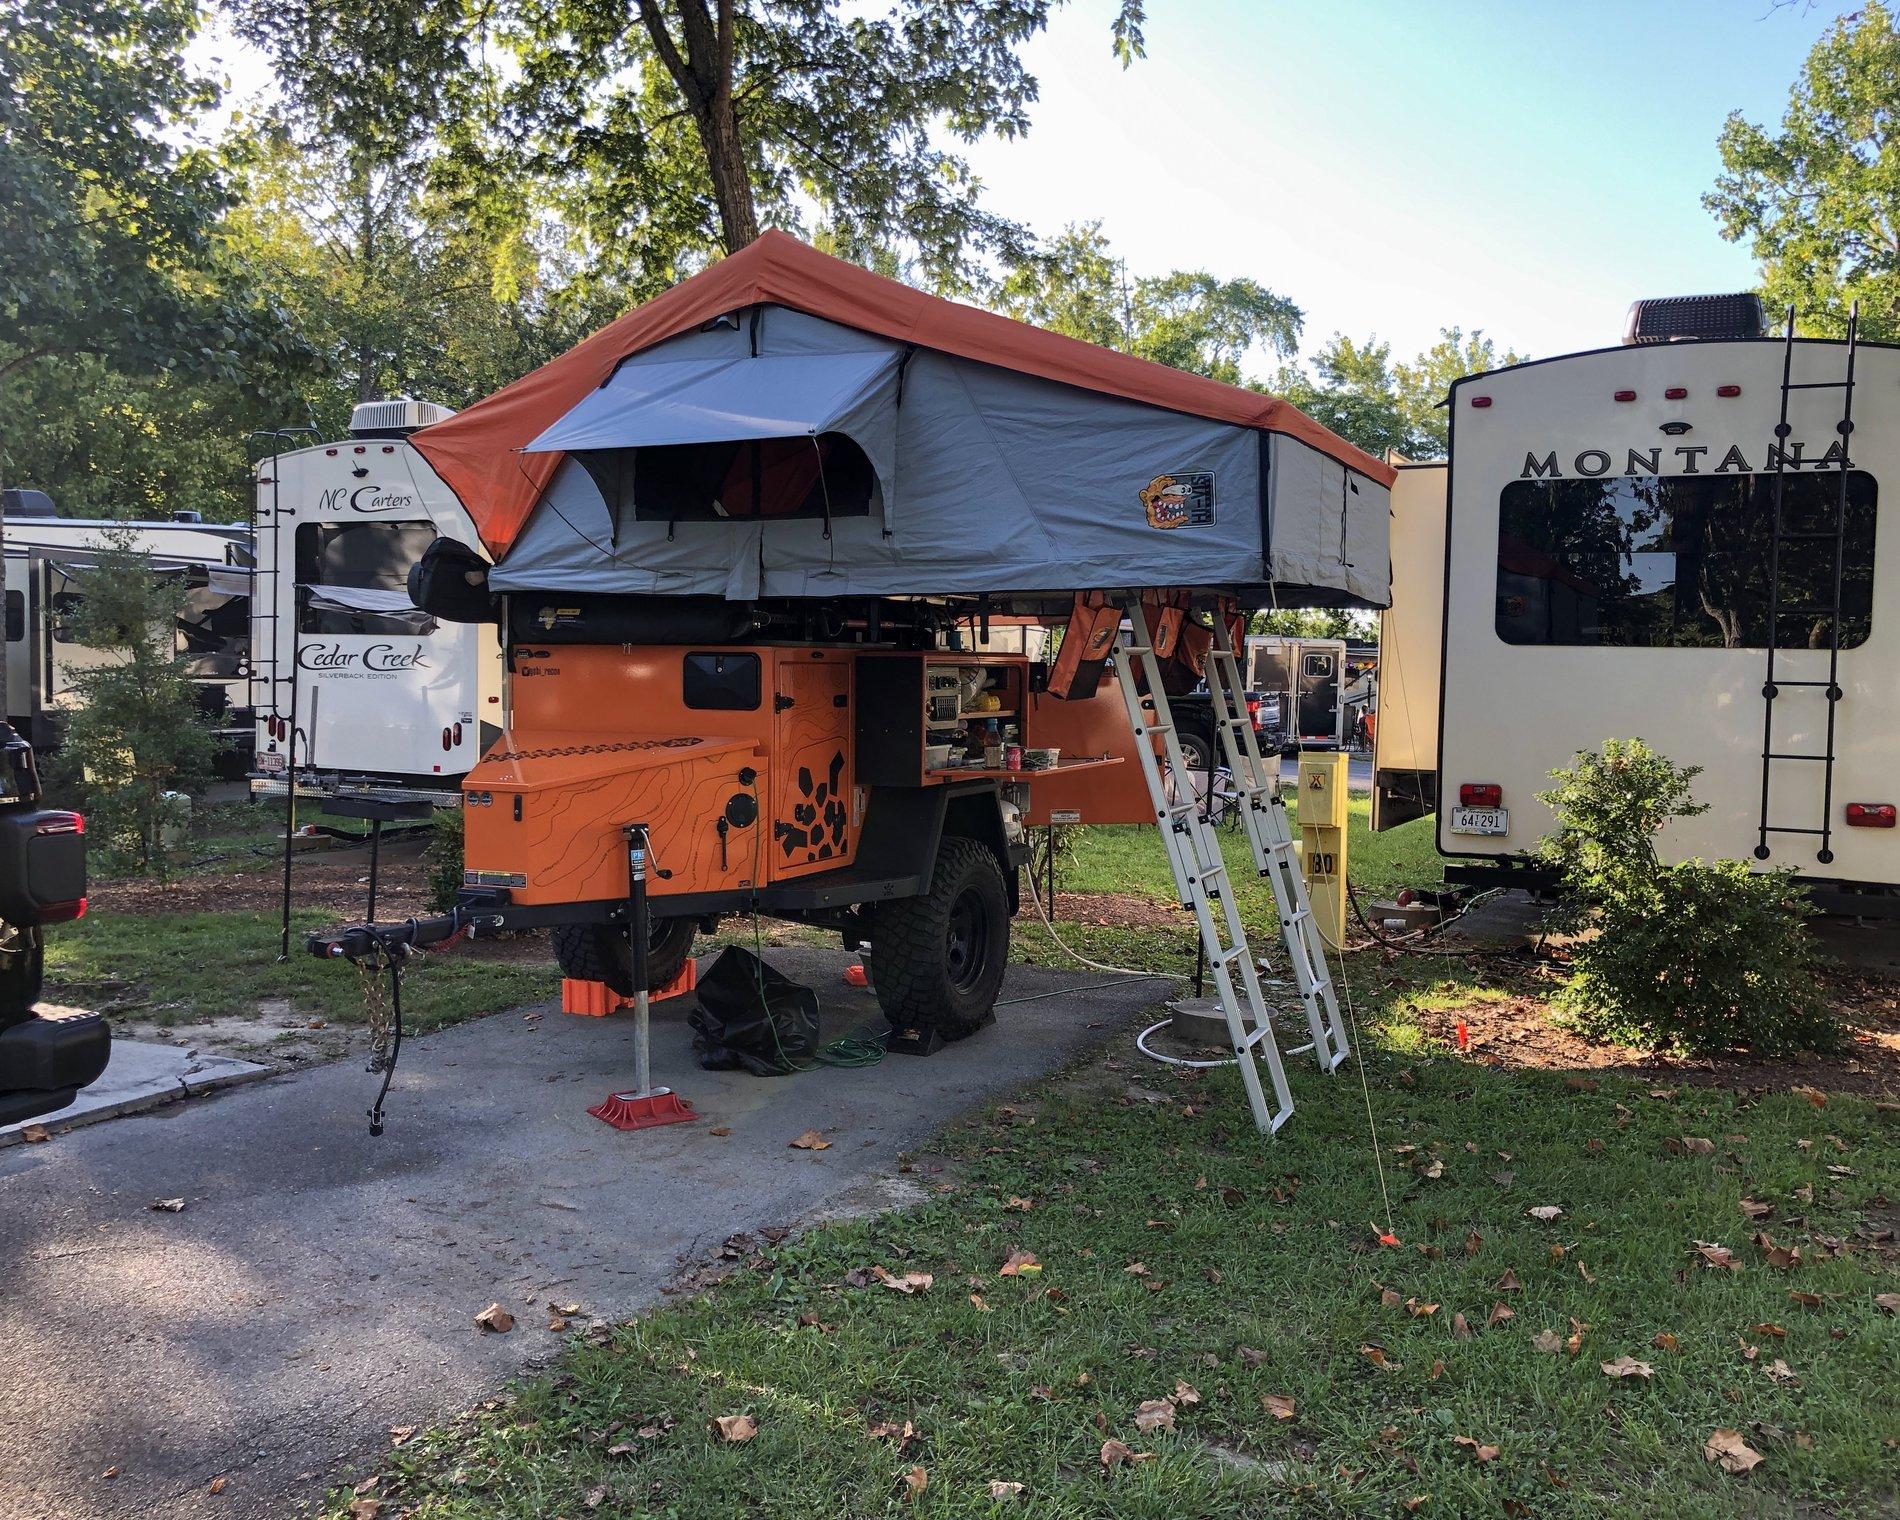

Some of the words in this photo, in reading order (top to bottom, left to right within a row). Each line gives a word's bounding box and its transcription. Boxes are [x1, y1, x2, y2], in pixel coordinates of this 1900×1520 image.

[1520, 441, 1855, 478] MONTANA
[319, 488, 347, 511] NC
[350, 486, 412, 513] Carters
[298, 643, 359, 671] Cedar
[362, 643, 432, 672] Creek
